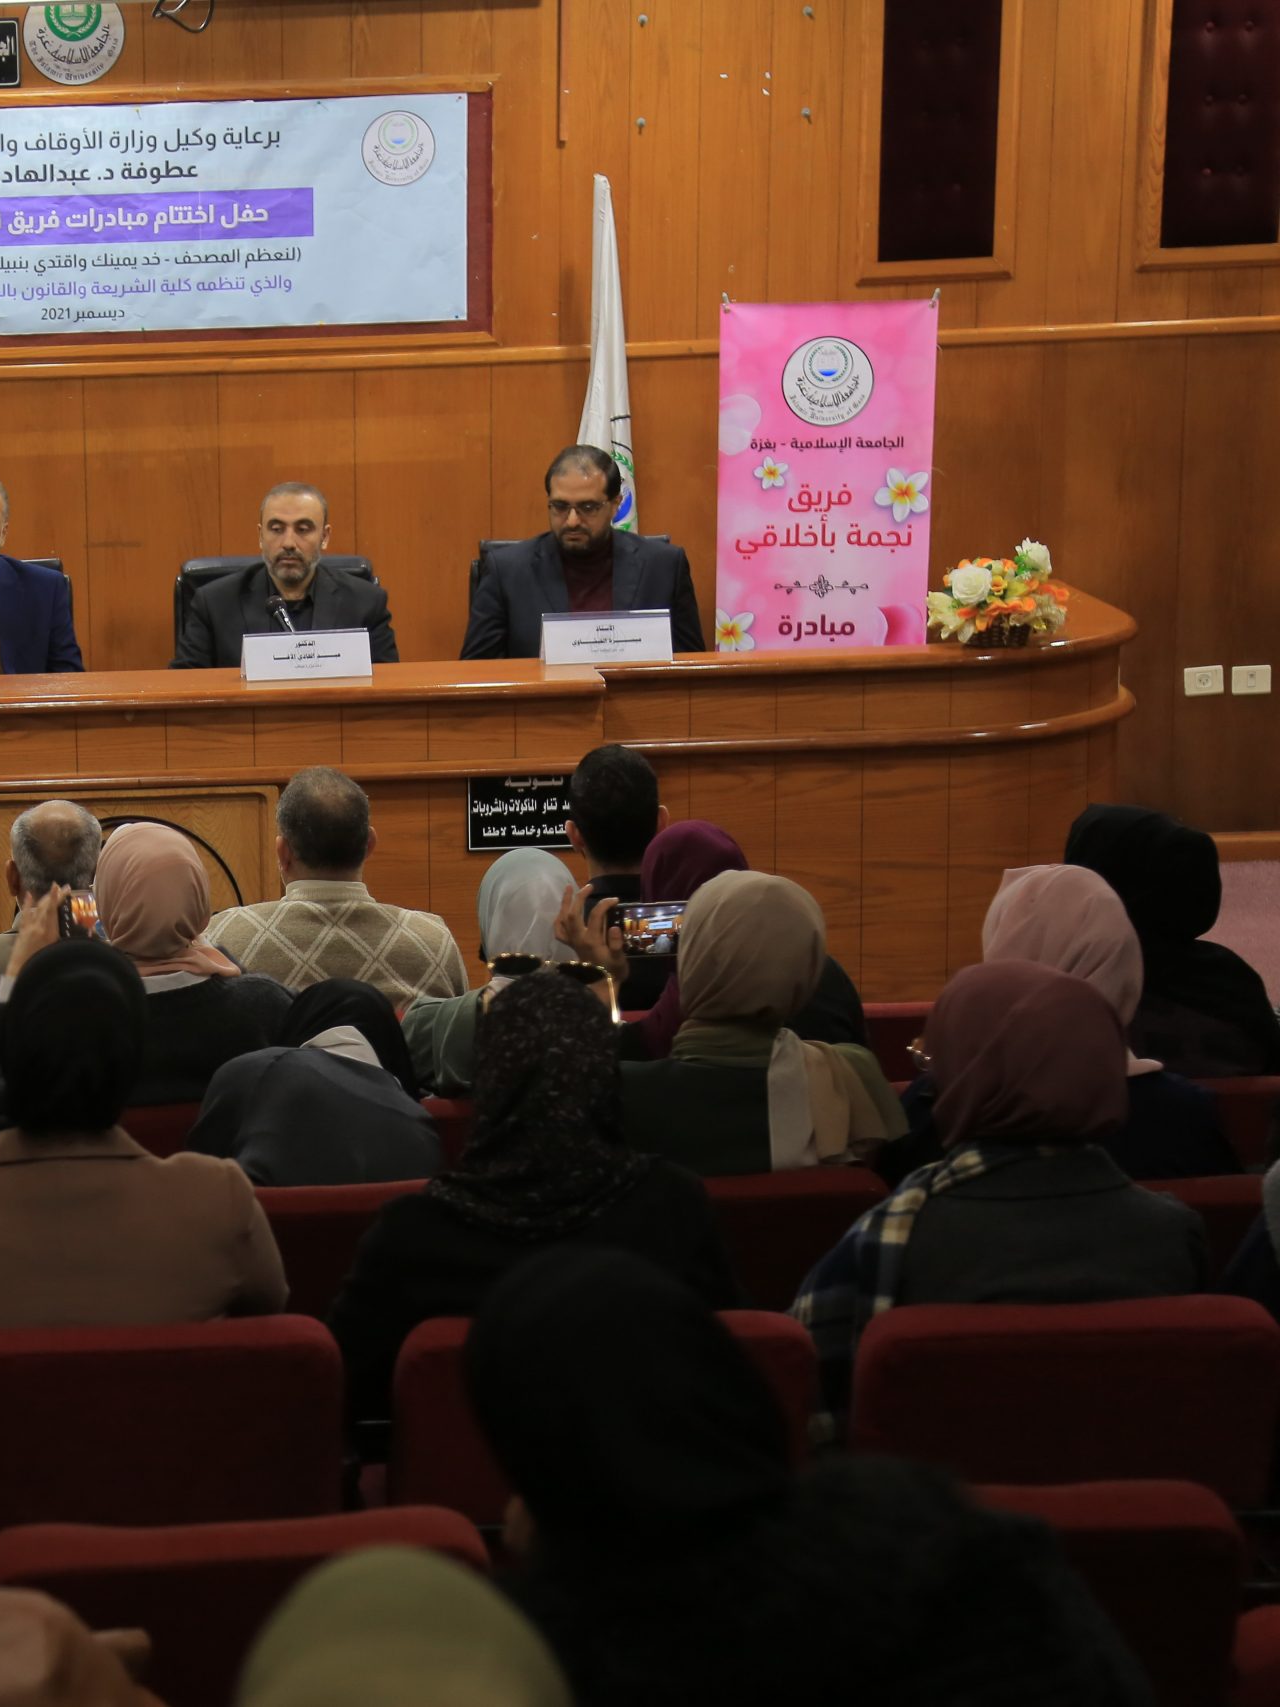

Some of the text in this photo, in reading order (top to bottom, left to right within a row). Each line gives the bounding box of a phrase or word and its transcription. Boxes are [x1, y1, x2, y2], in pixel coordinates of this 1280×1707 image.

[24, 128, 102, 156] الأوقاف
[109, 129, 158, 154] وزارة
[163, 128, 217, 153] وكيل
[223, 126, 281, 150] برعاية
[97, 167, 114, 180] د.
[121, 160, 199, 184] عطوفة
[7, 209, 60, 235] فريق
[65, 207, 148, 232] مبادرات
[153, 204, 215, 234] اختتام
[221, 203, 269, 229] حفل
[34, 254, 87, 277] واقتدي
[91, 253, 137, 270] يمينك
[174, 248, 240, 265] المصحف
[244, 247, 301, 269] (لنعظم
[21, 281, 87, 301] والقانون
[91, 277, 156, 298] الشريعة
[160, 278, 191, 296] كلية
[196, 275, 245, 292] تنظمه
[249, 275, 293, 298] والذي
[40, 307, 125, 323] ديسمبر 2021
[750, 437, 777, 451] بغزة
[790, 437, 852, 453] الإسلامية
[856, 436, 905, 450] الجامعة
[786, 483, 853, 513] فريق
[734, 513, 913, 561] نجمة بأخلاقي
[777, 614, 856, 642] مبادرة
[510, 825, 541, 838] وخاصة
